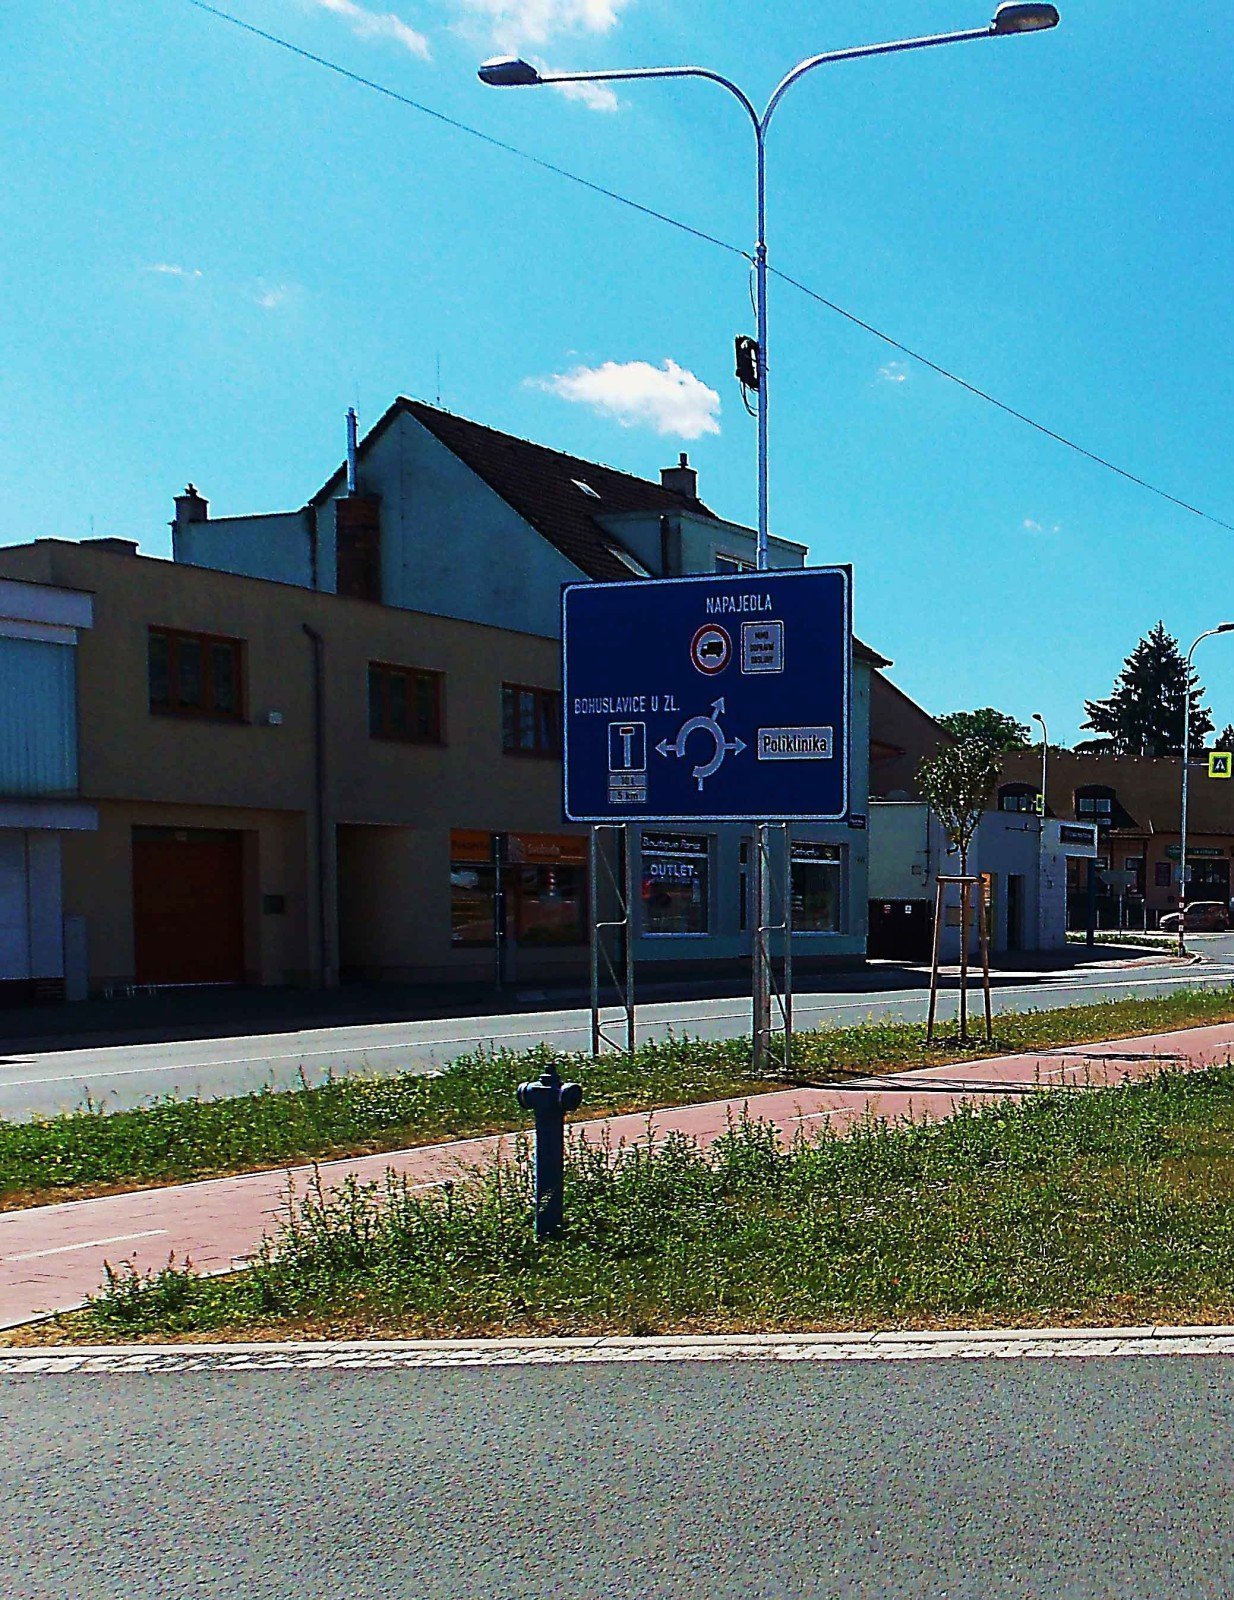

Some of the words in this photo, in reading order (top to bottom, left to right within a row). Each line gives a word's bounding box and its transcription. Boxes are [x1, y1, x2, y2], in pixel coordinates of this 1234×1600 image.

[706, 594, 772, 614] NAPAJEDLA
[574, 696, 646, 714] BOHUSLAVICE
[651, 695, 659, 712] U
[664, 695, 680, 711] ZL.
[763, 734, 827, 753] Poliklinika
